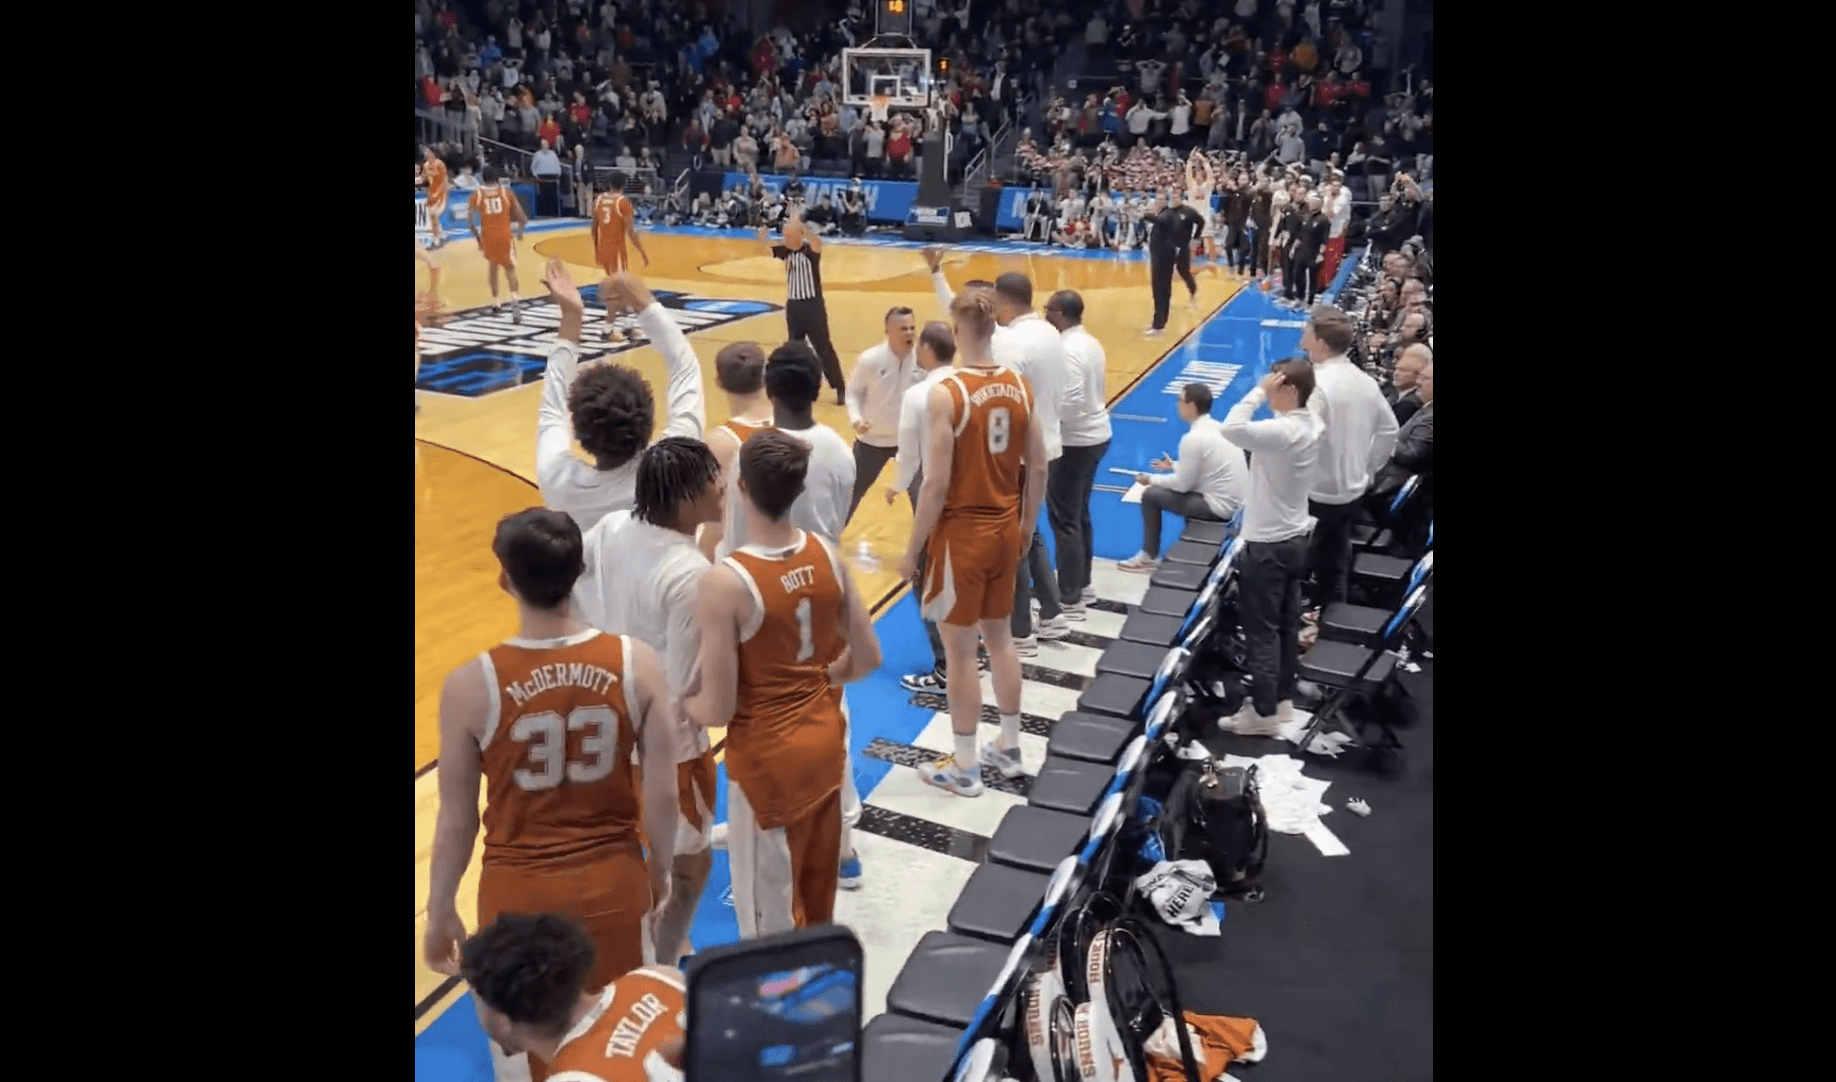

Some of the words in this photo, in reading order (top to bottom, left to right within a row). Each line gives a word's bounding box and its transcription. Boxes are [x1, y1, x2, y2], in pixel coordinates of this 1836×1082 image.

[484, 197, 502, 214] 10
[988, 406, 1010, 454] 8
[781, 566, 815, 594] BOTT
[796, 597, 815, 662] 1
[506, 662, 618, 707] McDERMOTT
[510, 704, 620, 791] 33
[1166, 885, 1195, 918] HERE
[604, 993, 669, 1058] TAYLOR
